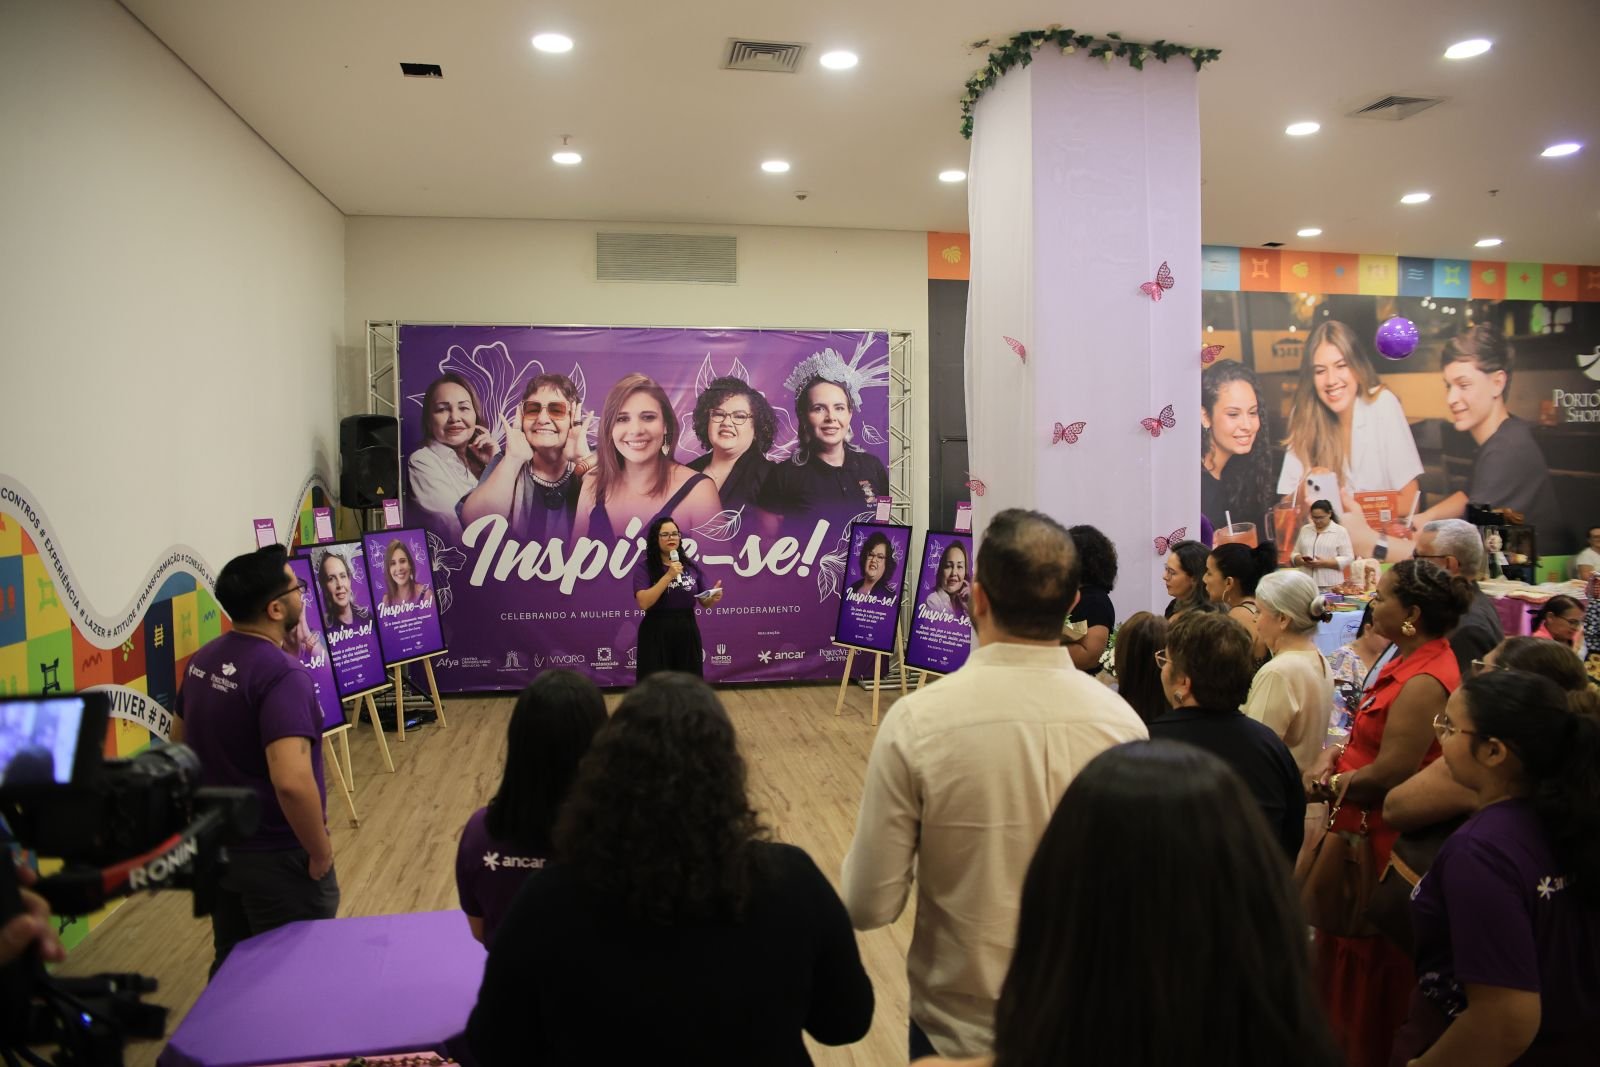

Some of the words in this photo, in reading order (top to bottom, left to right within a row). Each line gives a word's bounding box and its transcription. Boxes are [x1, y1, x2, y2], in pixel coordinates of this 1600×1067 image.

[1553, 388, 1600, 407] PORTO
[1567, 407, 1600, 423] SHOP
[1, 487, 40, 529] CONTROS
[44, 538, 80, 611] EXPERIÊNCIA
[84, 615, 106, 638] LAZER
[113, 608, 137, 637] ATITUDE
[185, 554, 206, 577] CONEXÃO
[461, 513, 831, 595] Inspie-se!
[377, 594, 433, 619] Inspire-se!
[846, 586, 897, 607] Inspire-se!
[500, 612, 567, 621] CELEBRANDO
[570, 611, 577, 619] A
[580, 610, 621, 619] MULHER
[624, 610, 630, 618] E
[634, 609, 646, 617] PR
[705, 607, 712, 615] O
[716, 605, 801, 615] EMPODERAMENTO
[917, 603, 971, 628] Inspire-se
[327, 619, 373, 647] spire-se!
[436, 657, 459, 669] Afya
[774, 651, 806, 660] ancar
[106, 690, 146, 720] VIVER
[158, 713, 172, 736] PA
[129, 836, 198, 890] RONIN
[501, 855, 547, 868] ancar
